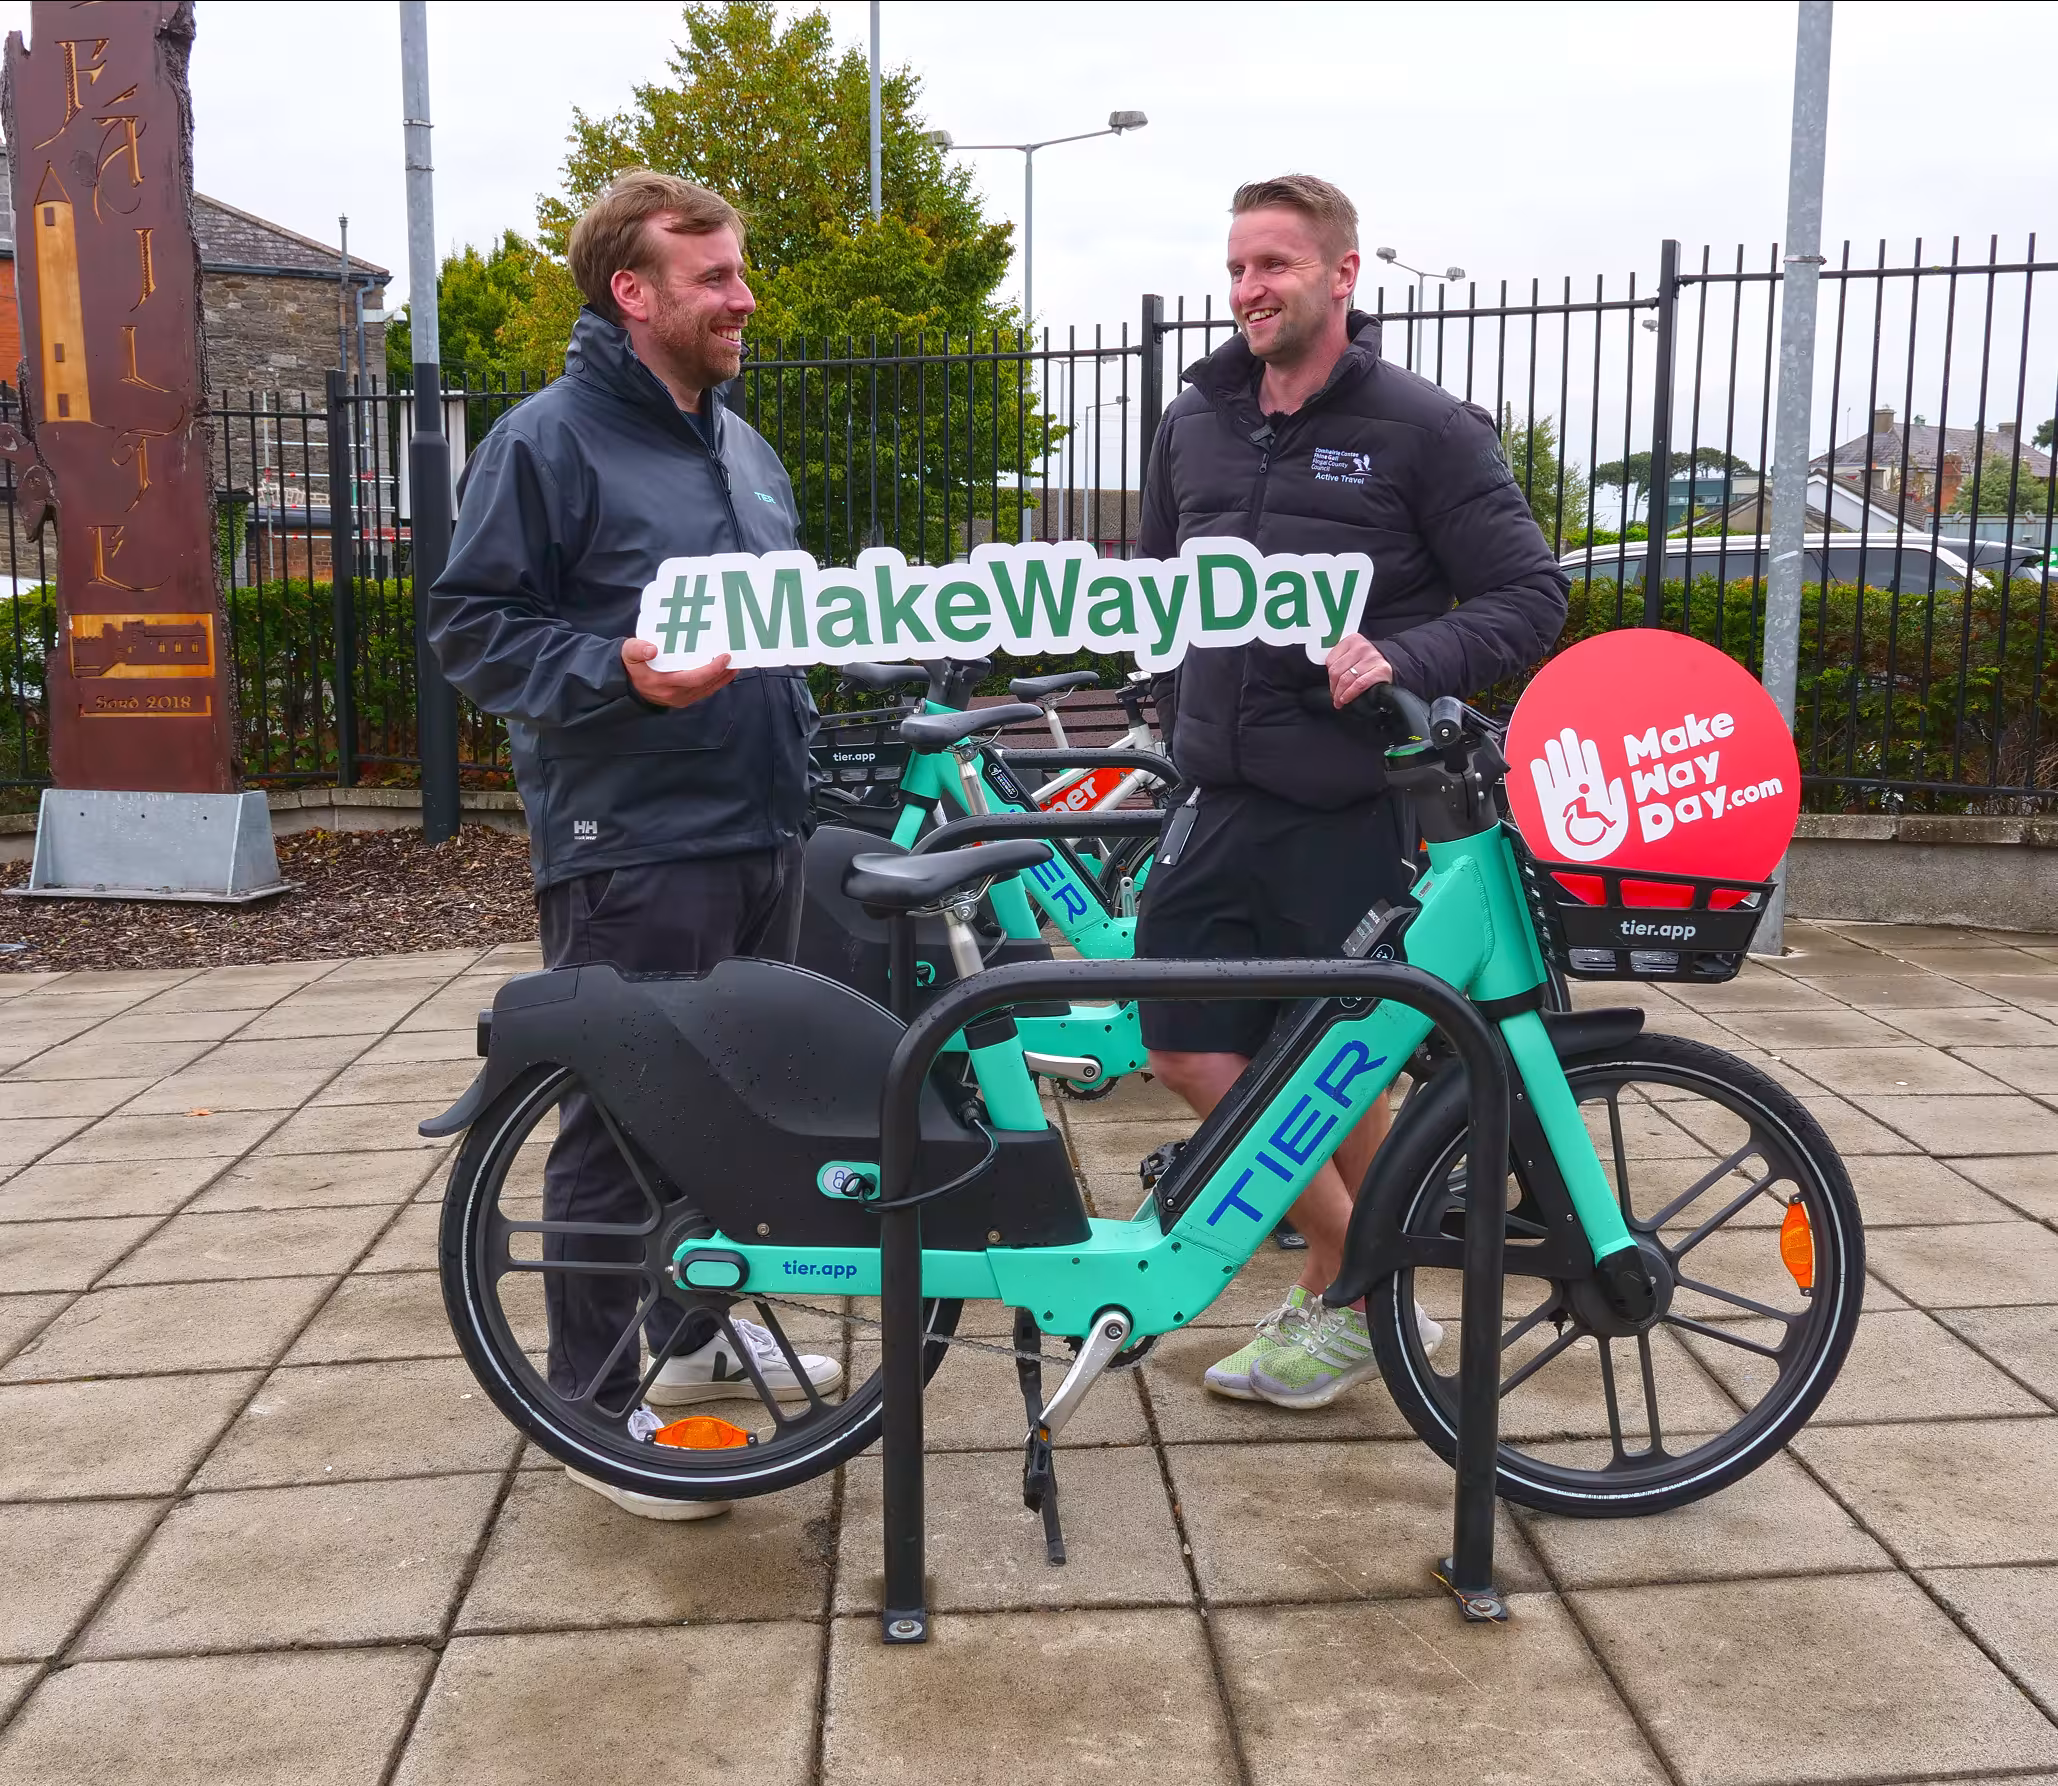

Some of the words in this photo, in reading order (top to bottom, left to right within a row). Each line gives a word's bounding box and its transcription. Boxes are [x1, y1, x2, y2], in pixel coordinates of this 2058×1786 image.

[1328, 460, 1348, 468] County
[1315, 472, 1338, 481] Active
[1341, 475, 1364, 484] Travel
[655, 553, 1359, 655] #MakeWayDay
[145, 695, 192, 709] 2018
[1623, 712, 1735, 767] Make
[833, 752, 876, 762] tier.app
[1631, 750, 1720, 804] Way
[573, 820, 598, 834] HH
[1028, 858, 1088, 924] ER
[1620, 919, 1697, 940] tier.app
[1206, 1040, 1388, 1227] TIER
[782, 1260, 858, 1279] tier.app
